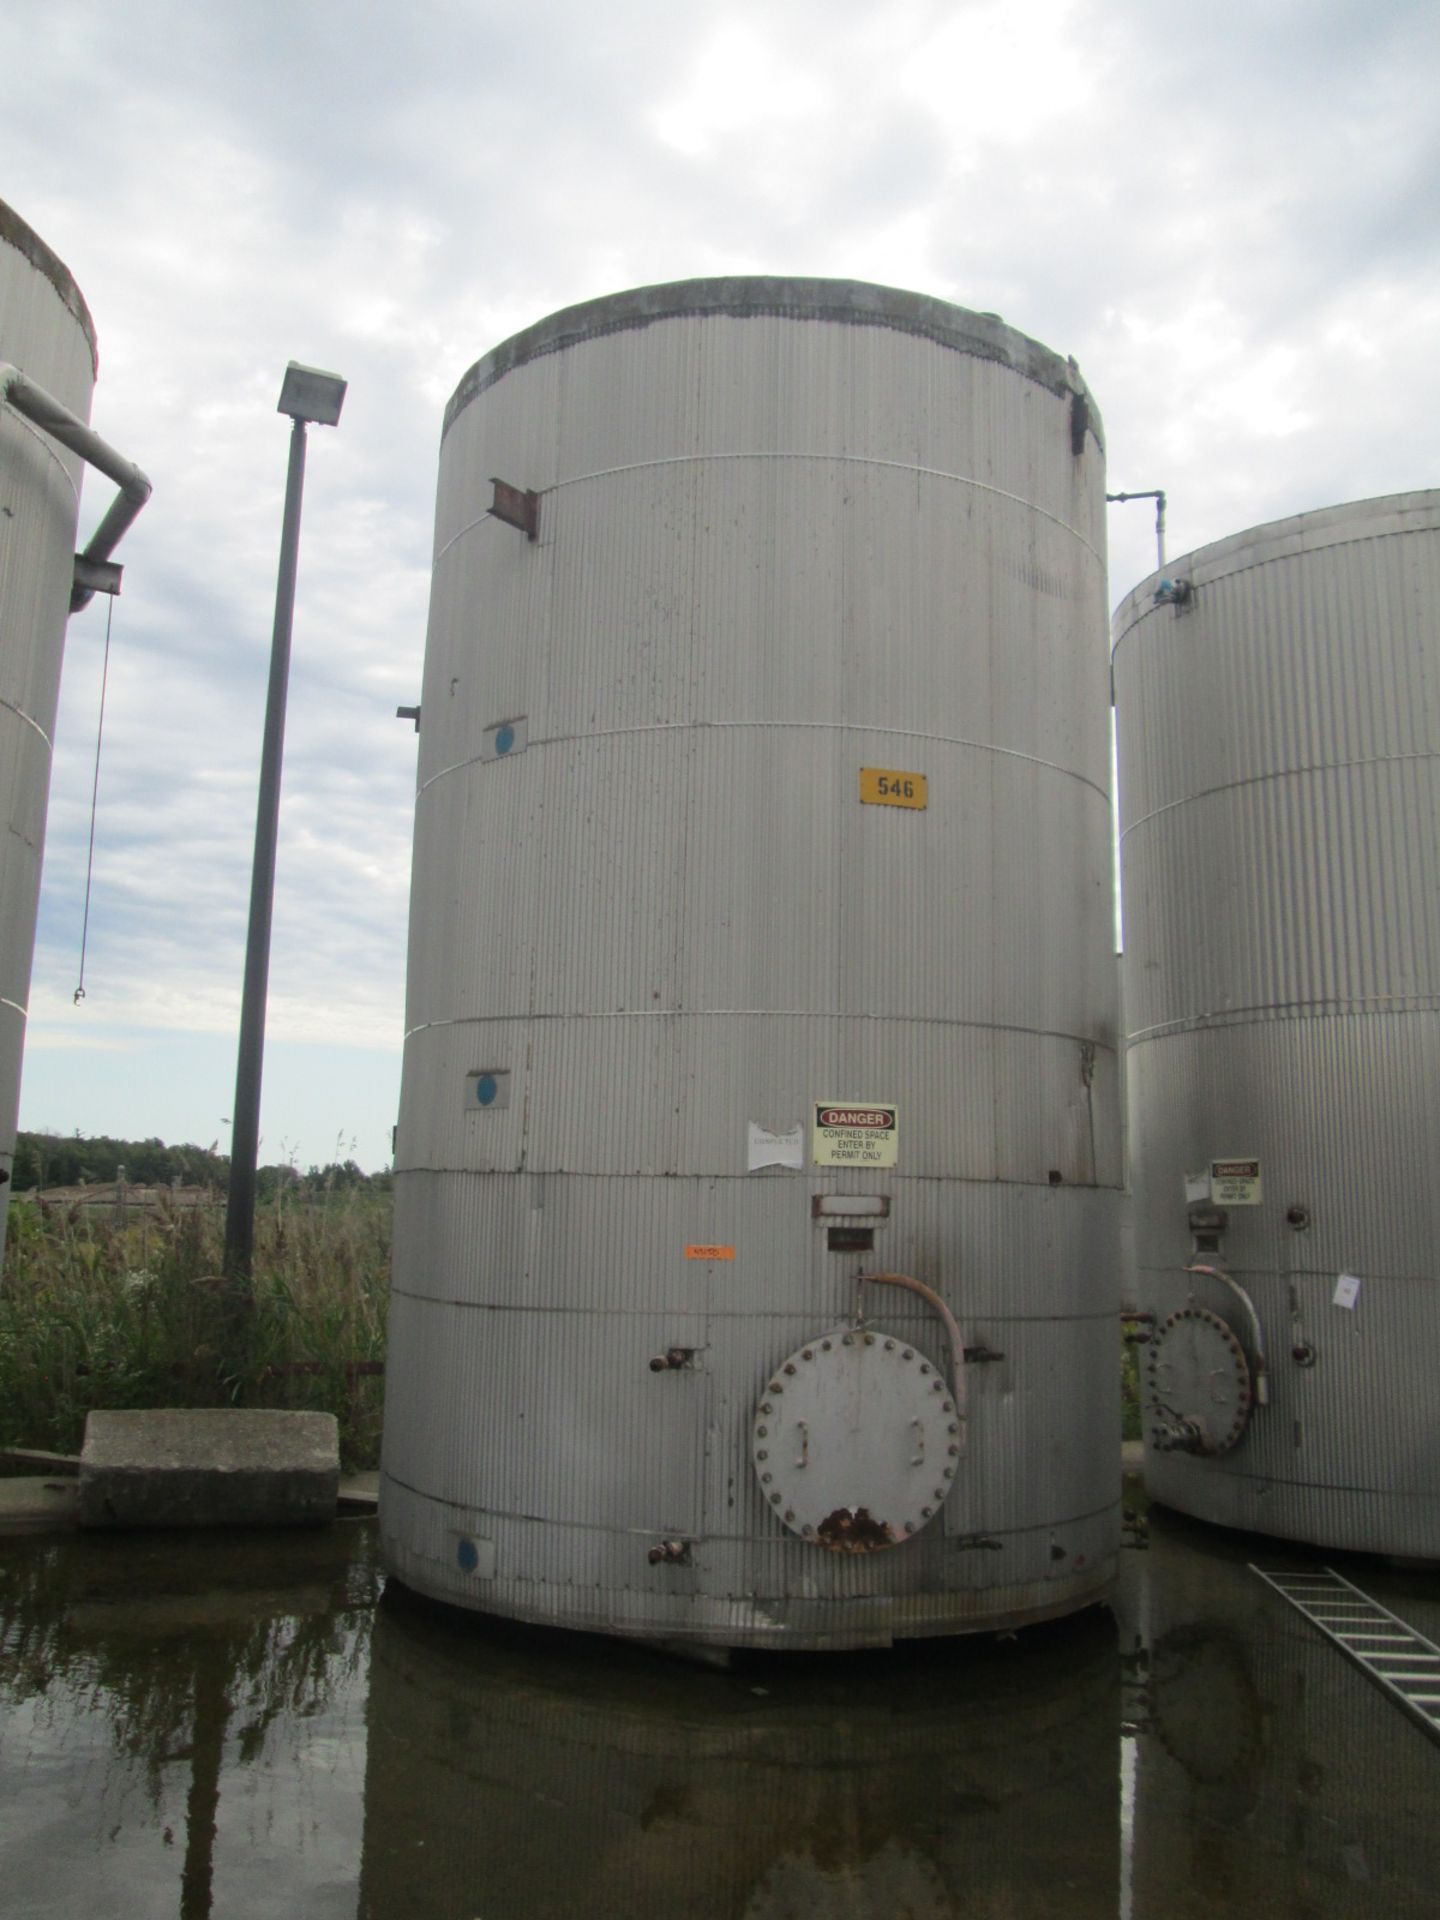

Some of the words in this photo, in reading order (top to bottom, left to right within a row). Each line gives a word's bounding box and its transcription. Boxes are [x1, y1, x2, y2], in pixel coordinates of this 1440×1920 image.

[878, 777, 914, 799] 546
[828, 1112, 884, 1125] DANGER
[823, 1129, 863, 1139] CONFINED
[865, 1131, 890, 1140] SPACE
[838, 1140, 863, 1149] ENTER
[865, 1141, 876, 1150] BY
[831, 1150, 860, 1159] PERMIT
[862, 1151, 882, 1160] ONLY
